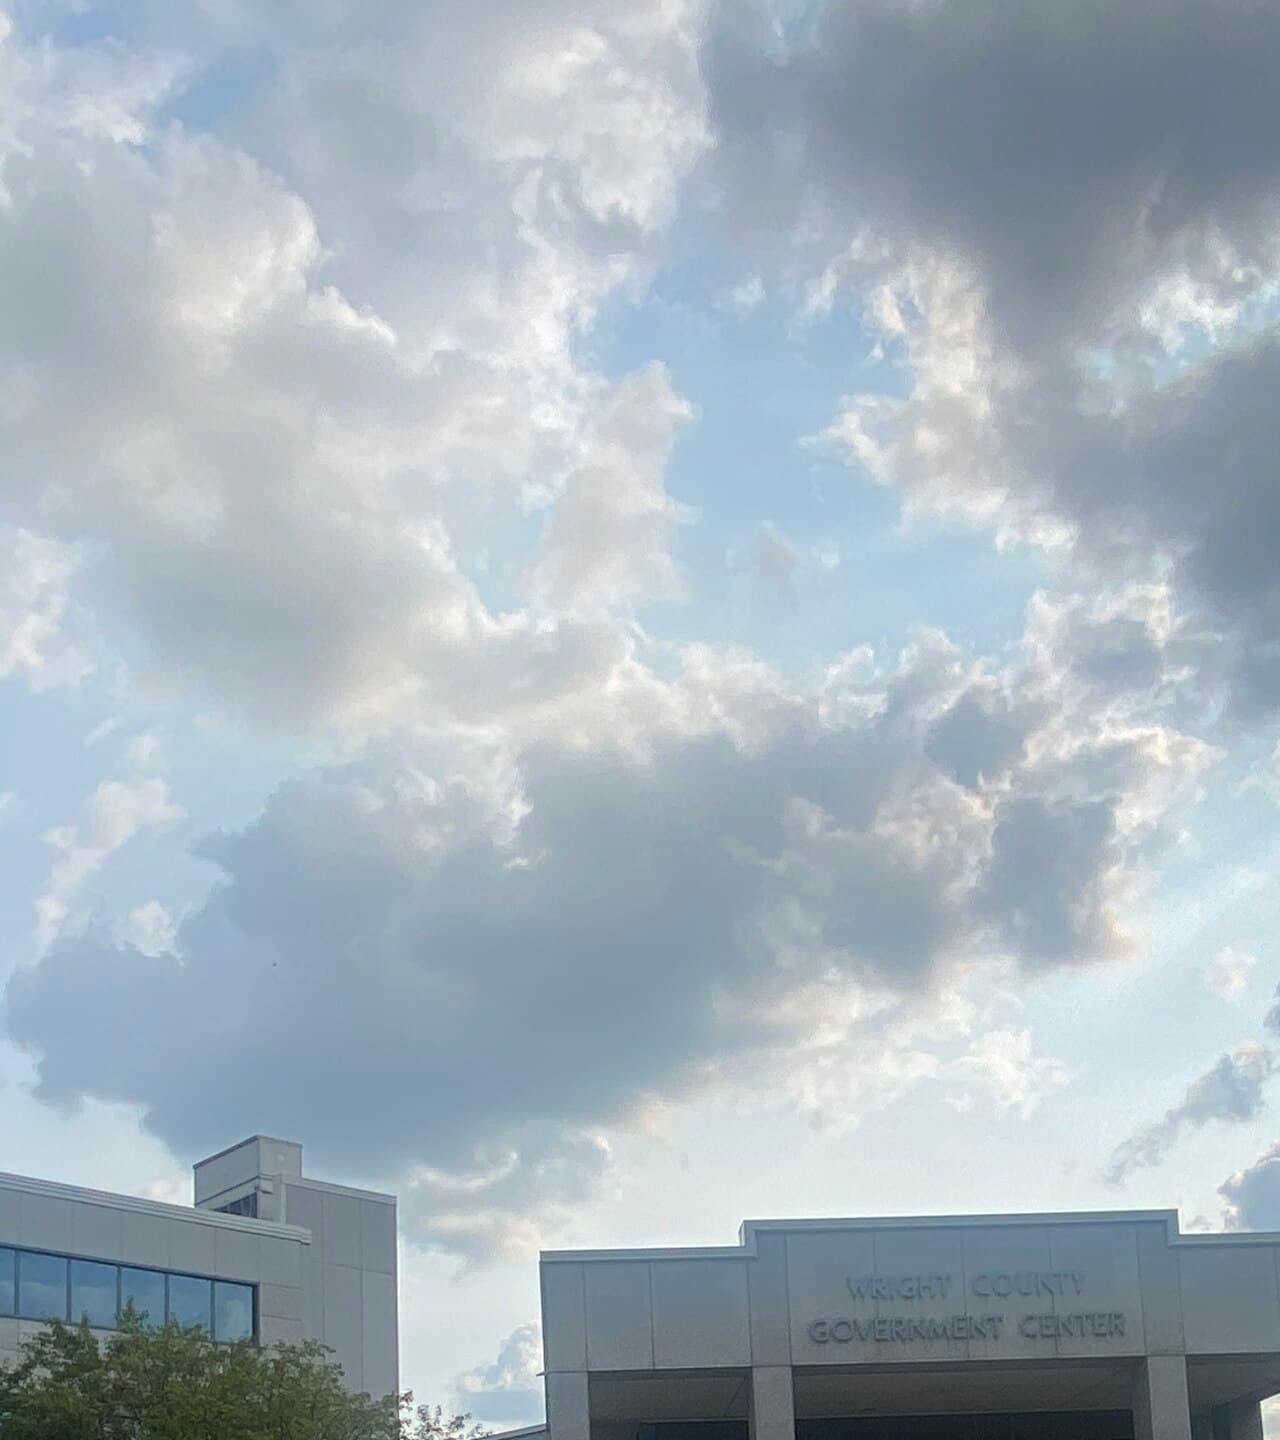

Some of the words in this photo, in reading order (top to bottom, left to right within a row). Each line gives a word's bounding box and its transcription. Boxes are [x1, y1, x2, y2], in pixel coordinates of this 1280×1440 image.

[846, 1273, 951, 1302] WRIGHT
[971, 1270, 1088, 1298] COUNTY
[808, 1315, 1003, 1345] GOVERNMENT
[1018, 1311, 1128, 1339] CENTER
